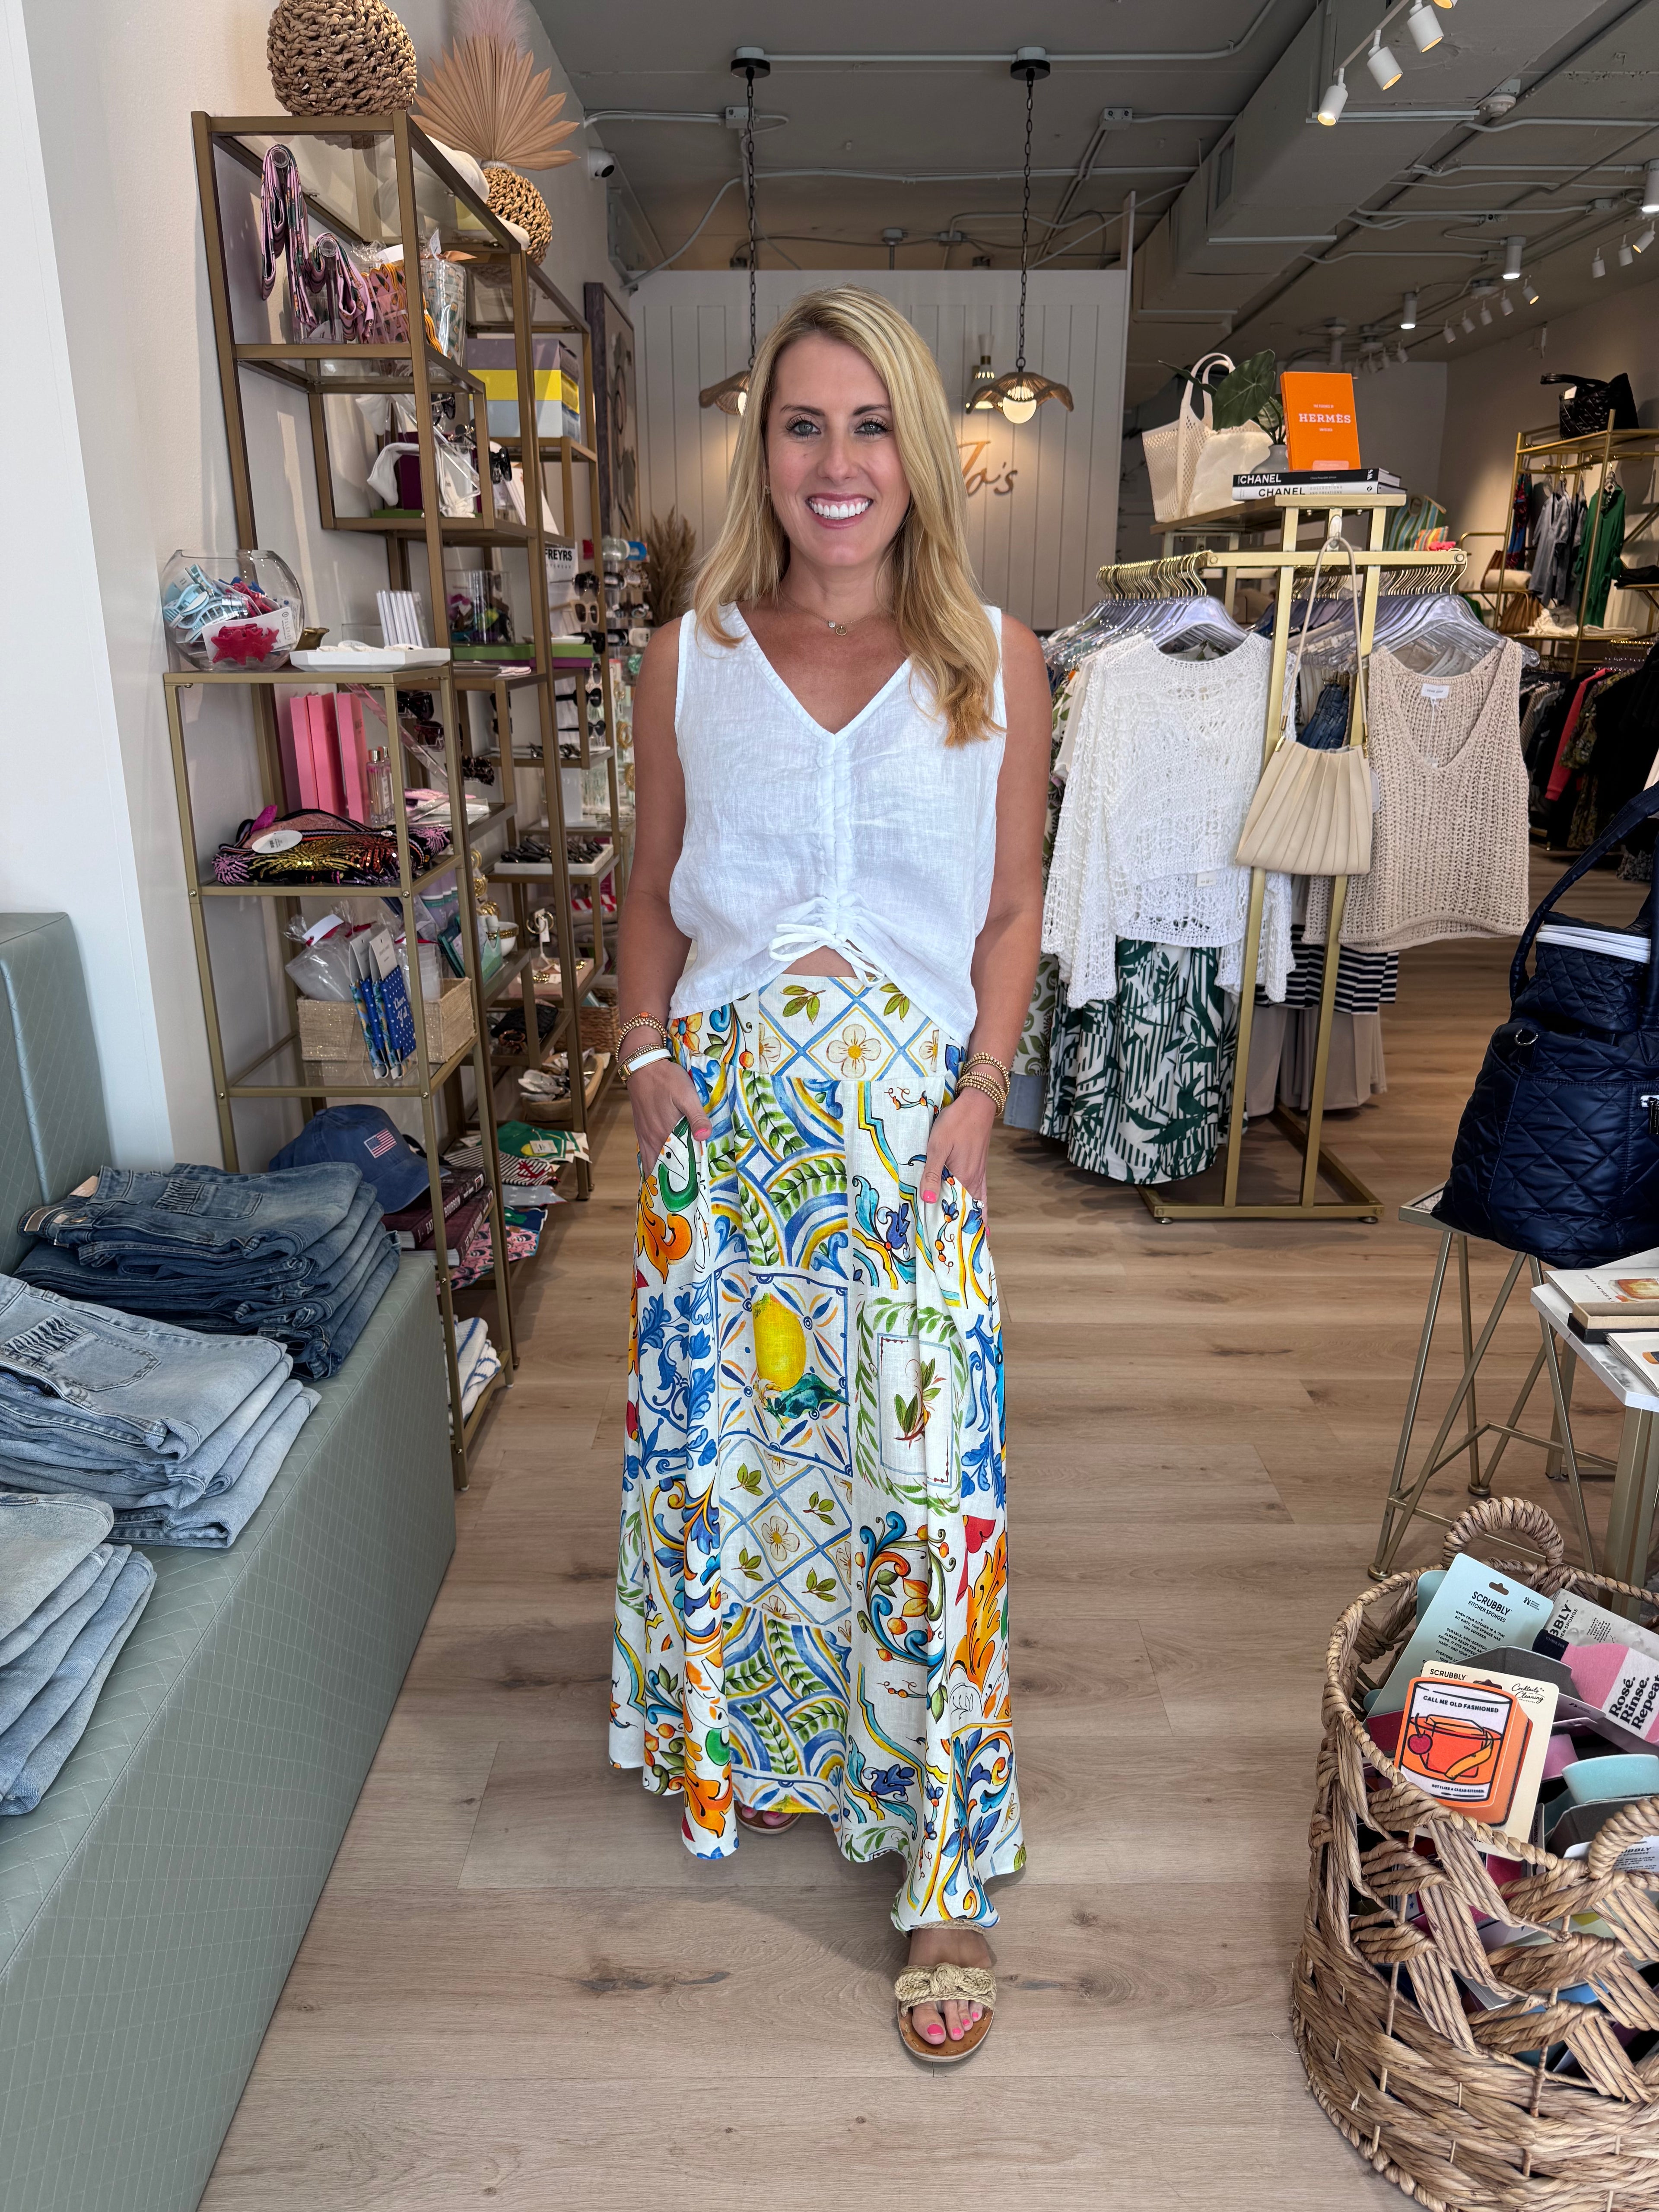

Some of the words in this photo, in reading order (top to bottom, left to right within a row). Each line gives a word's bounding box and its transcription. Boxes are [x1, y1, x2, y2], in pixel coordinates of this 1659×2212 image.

[1240, 474, 1281, 484] CHANEL
[1259, 487, 1305, 497] CHANEL
[1471, 1591, 1511, 1616] SCRUBBLY
[1468, 1600, 1486, 1613] KITCHEN
[1486, 1610, 1506, 1623] SPONGES
[1430, 1669, 1466, 1681] SCRUBBLY
[1511, 1683, 1539, 1693] Cocktails
[1515, 1691, 1544, 1704] Cleaning
[1608, 1677, 1636, 1718] Rosé.
[1620, 1677, 1650, 1724] Rinse.
[1463, 1704, 1499, 1713] FASHIONED
